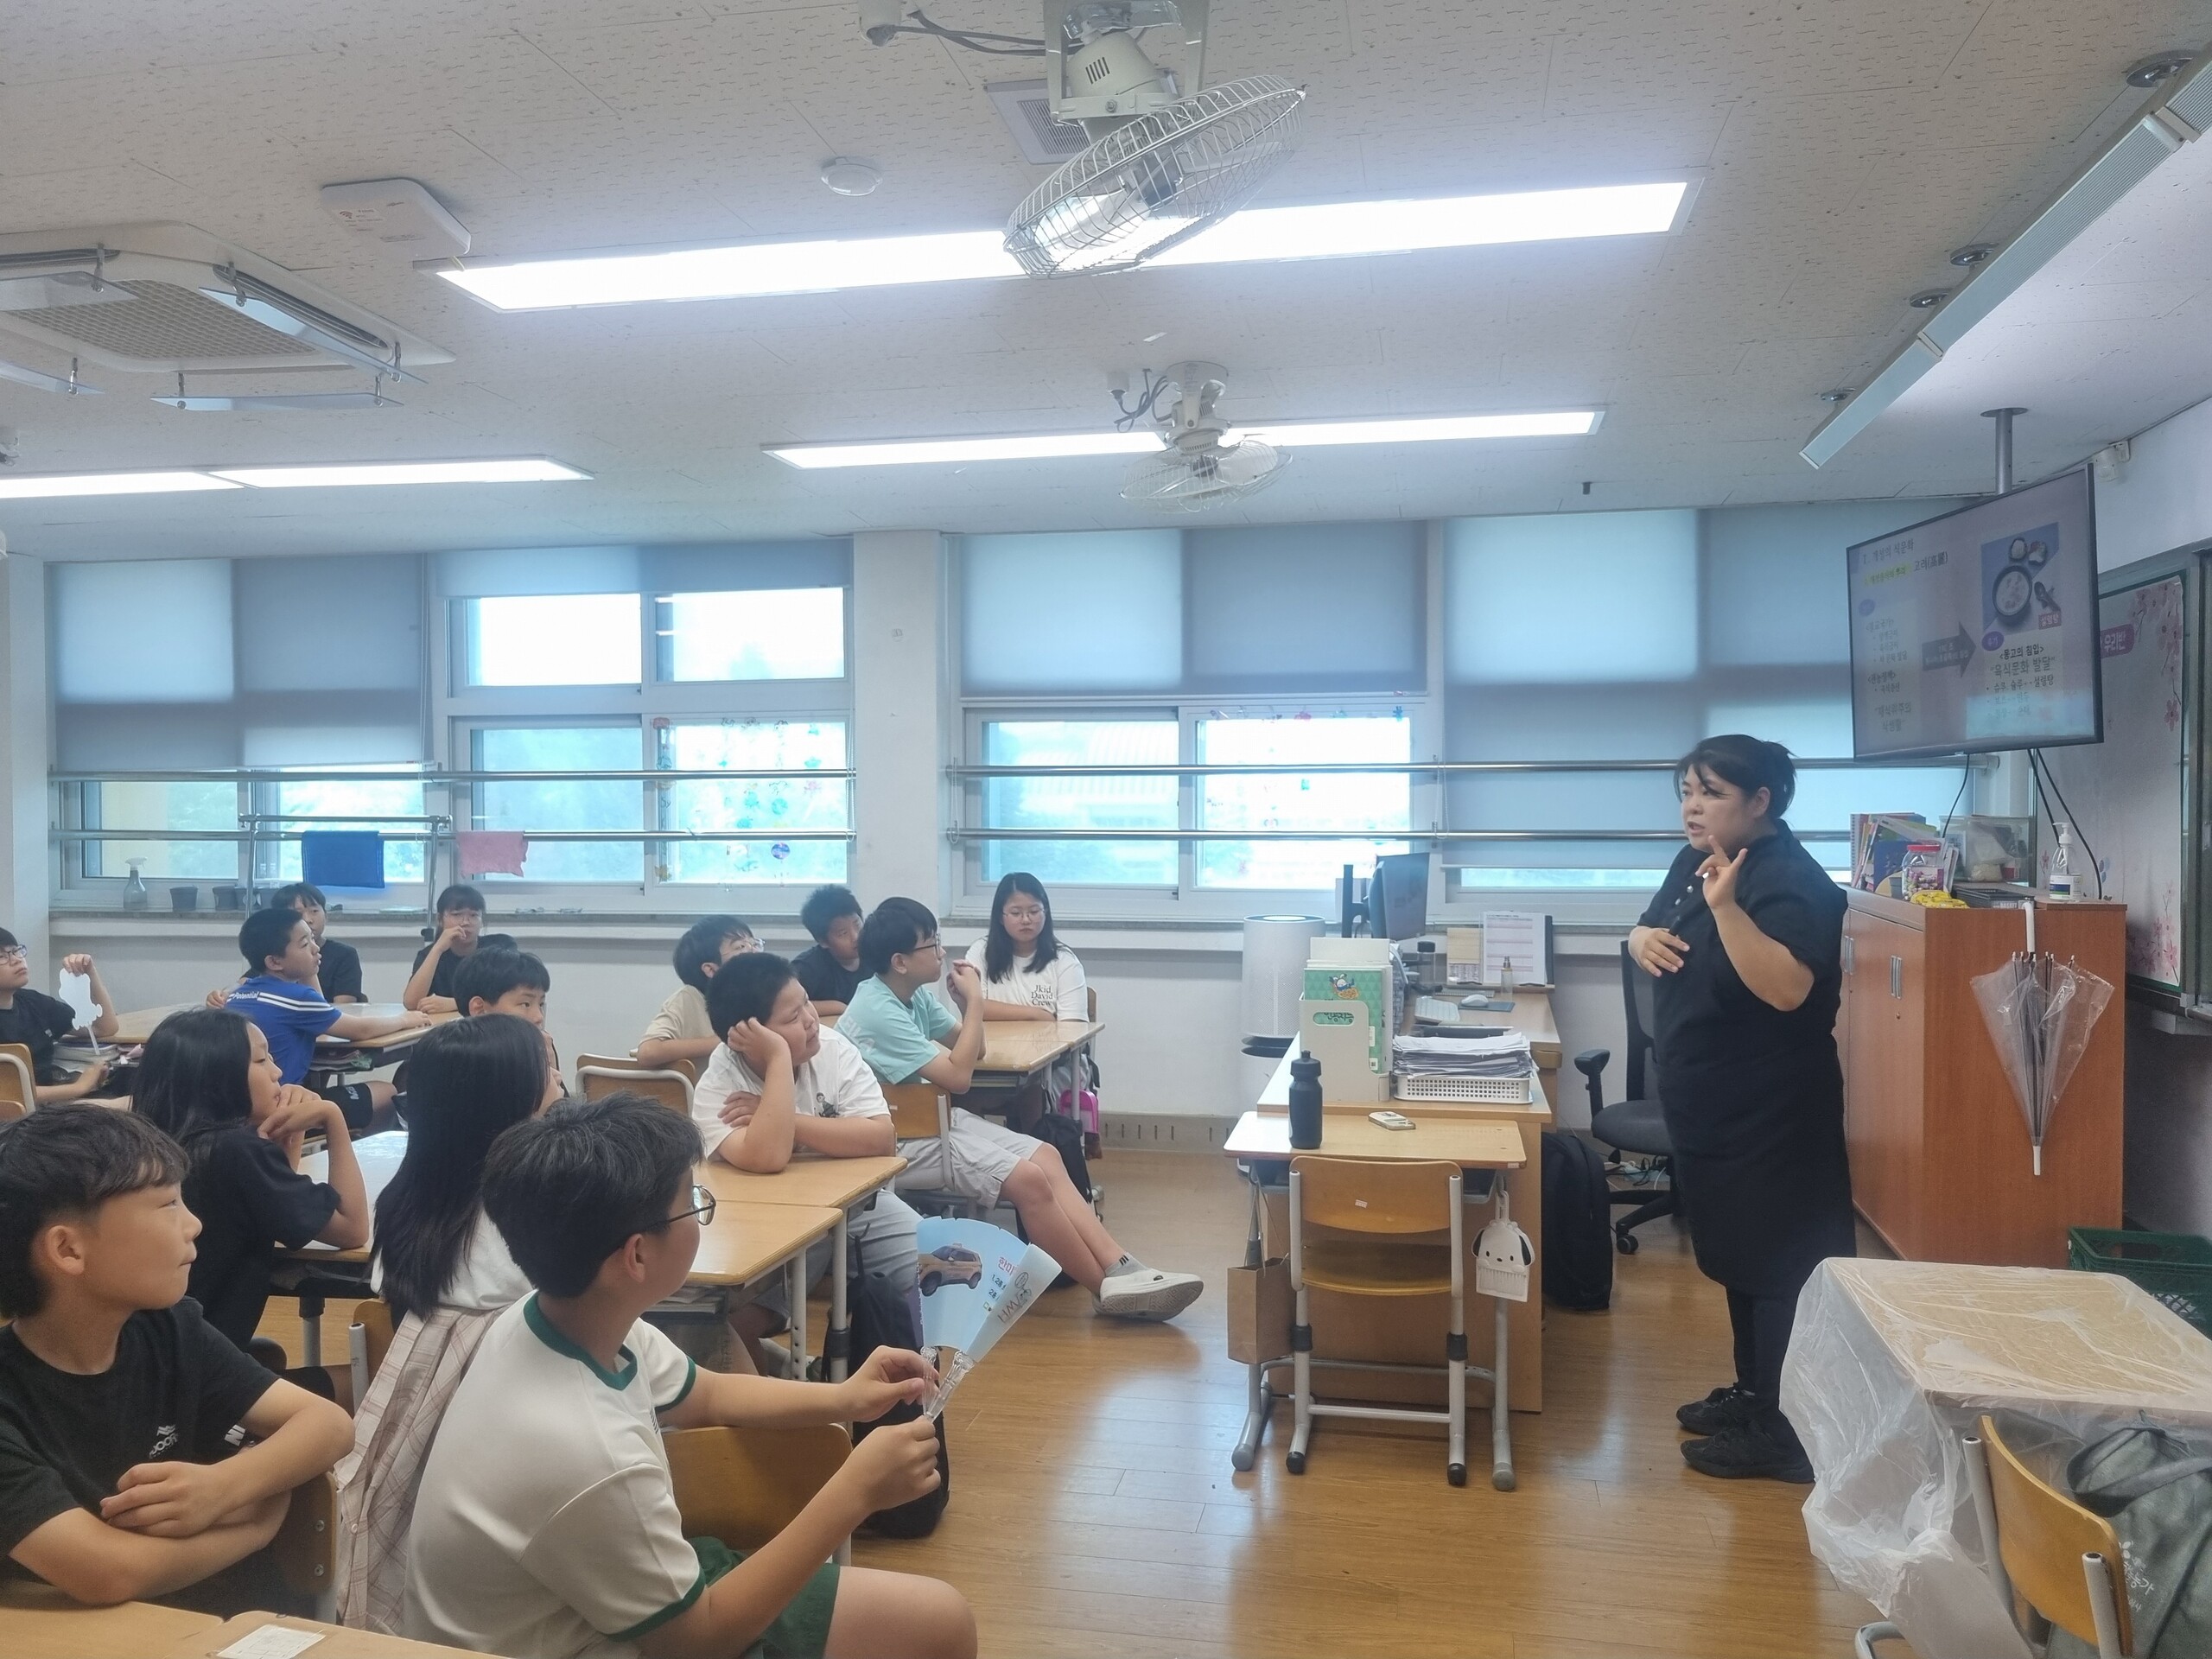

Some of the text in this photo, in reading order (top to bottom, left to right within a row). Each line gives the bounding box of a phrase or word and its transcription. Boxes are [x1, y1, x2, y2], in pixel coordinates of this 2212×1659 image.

[1893, 538, 1915, 555] 식문화
[2104, 631, 2126, 652] 우리반
[2025, 644, 2044, 657] 침입>
[1031, 991, 1053, 1001] David
